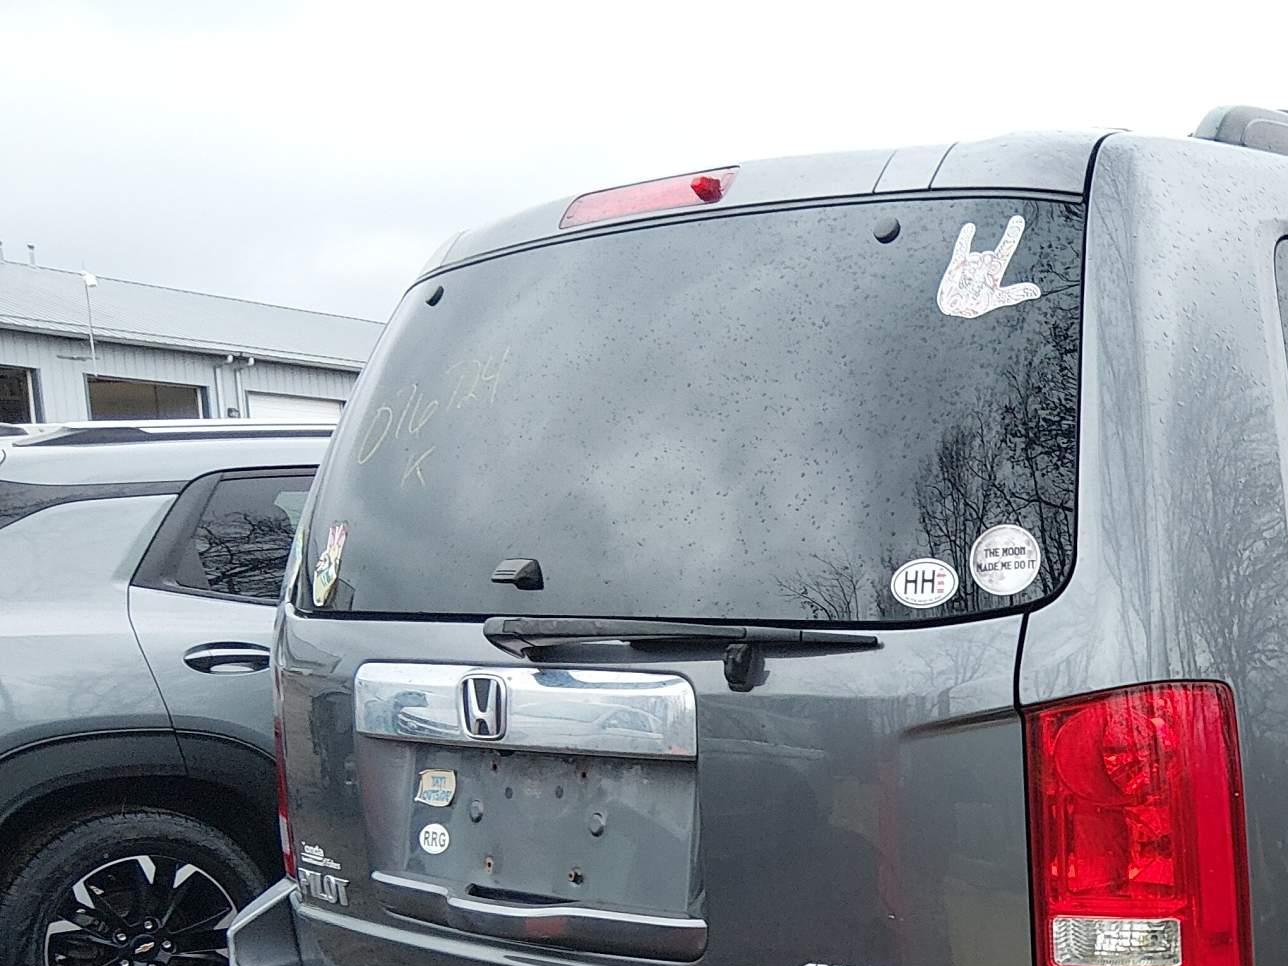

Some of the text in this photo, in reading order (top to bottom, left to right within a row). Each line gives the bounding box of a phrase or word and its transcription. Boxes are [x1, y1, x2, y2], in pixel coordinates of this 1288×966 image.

[400, 445, 436, 489] K
[984, 546, 1026, 559] THE MOON
[976, 559, 1037, 573] MADE ME DO IT
[423, 830, 447, 848] RRG
